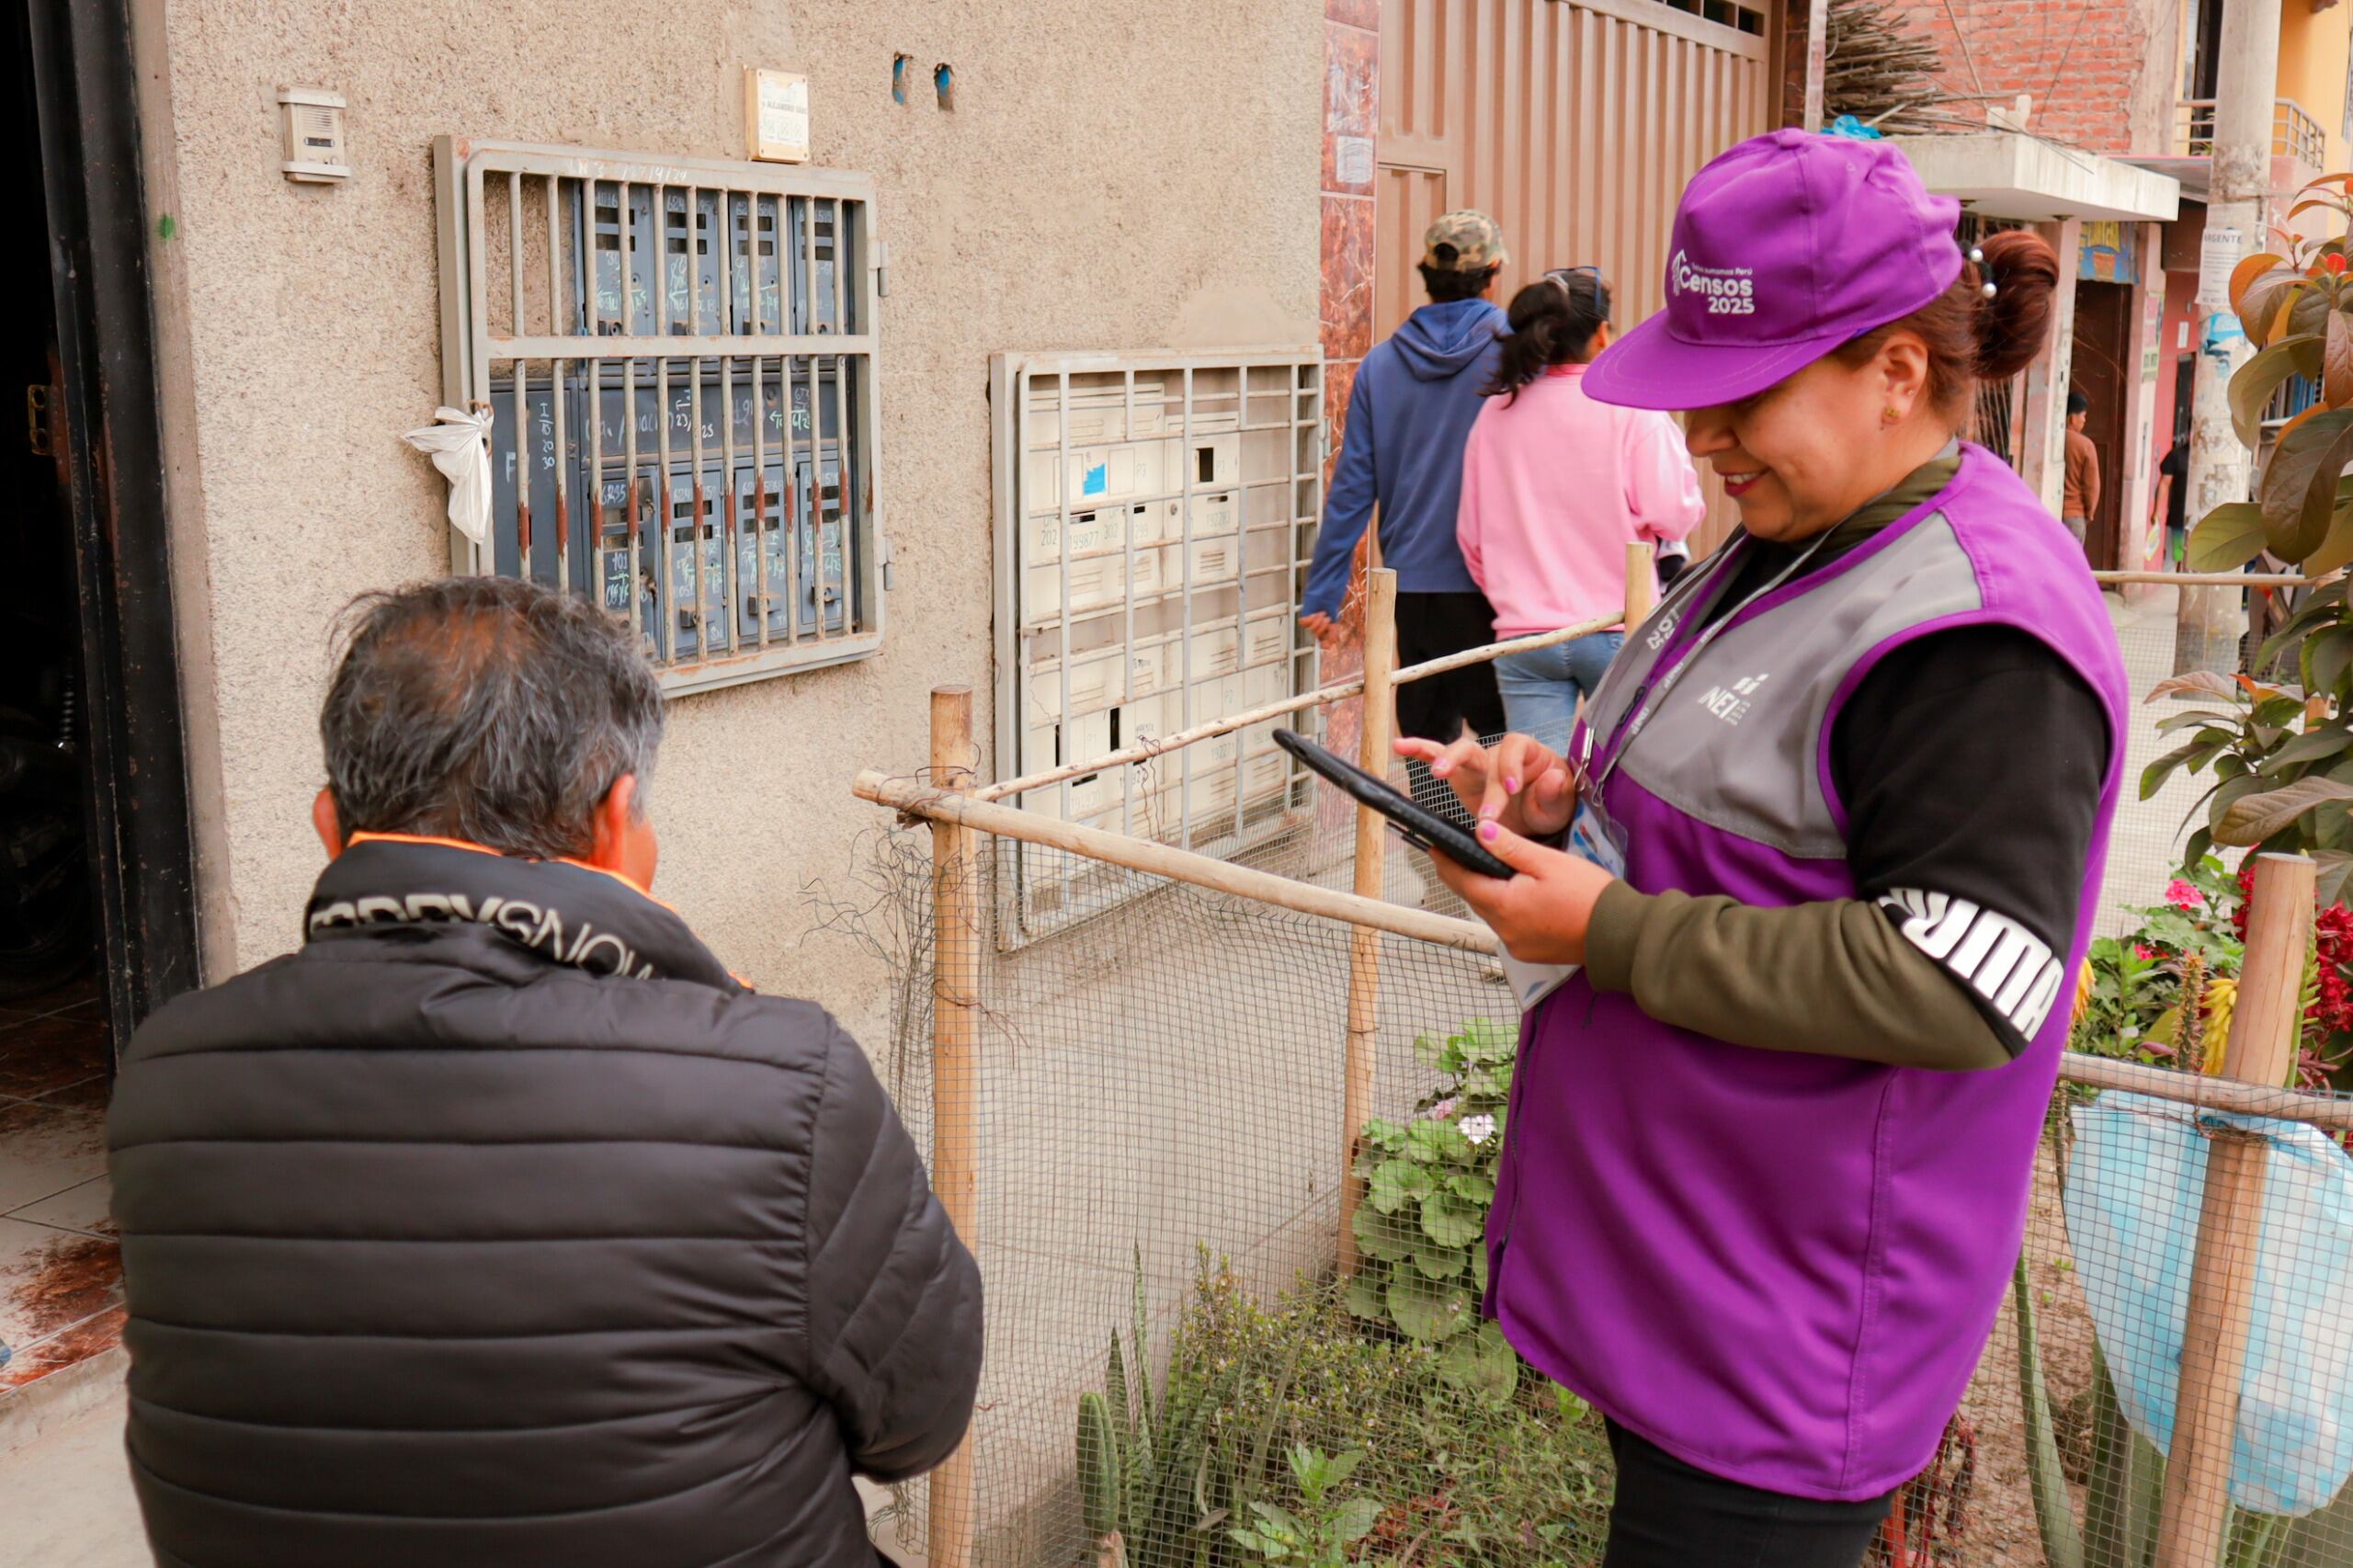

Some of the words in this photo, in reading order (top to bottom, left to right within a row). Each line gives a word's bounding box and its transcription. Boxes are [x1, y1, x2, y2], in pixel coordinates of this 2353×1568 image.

[1679, 266, 1754, 297] Censos
[1708, 296, 1755, 314] 2025
[1877, 888, 2064, 1043] PUMA
